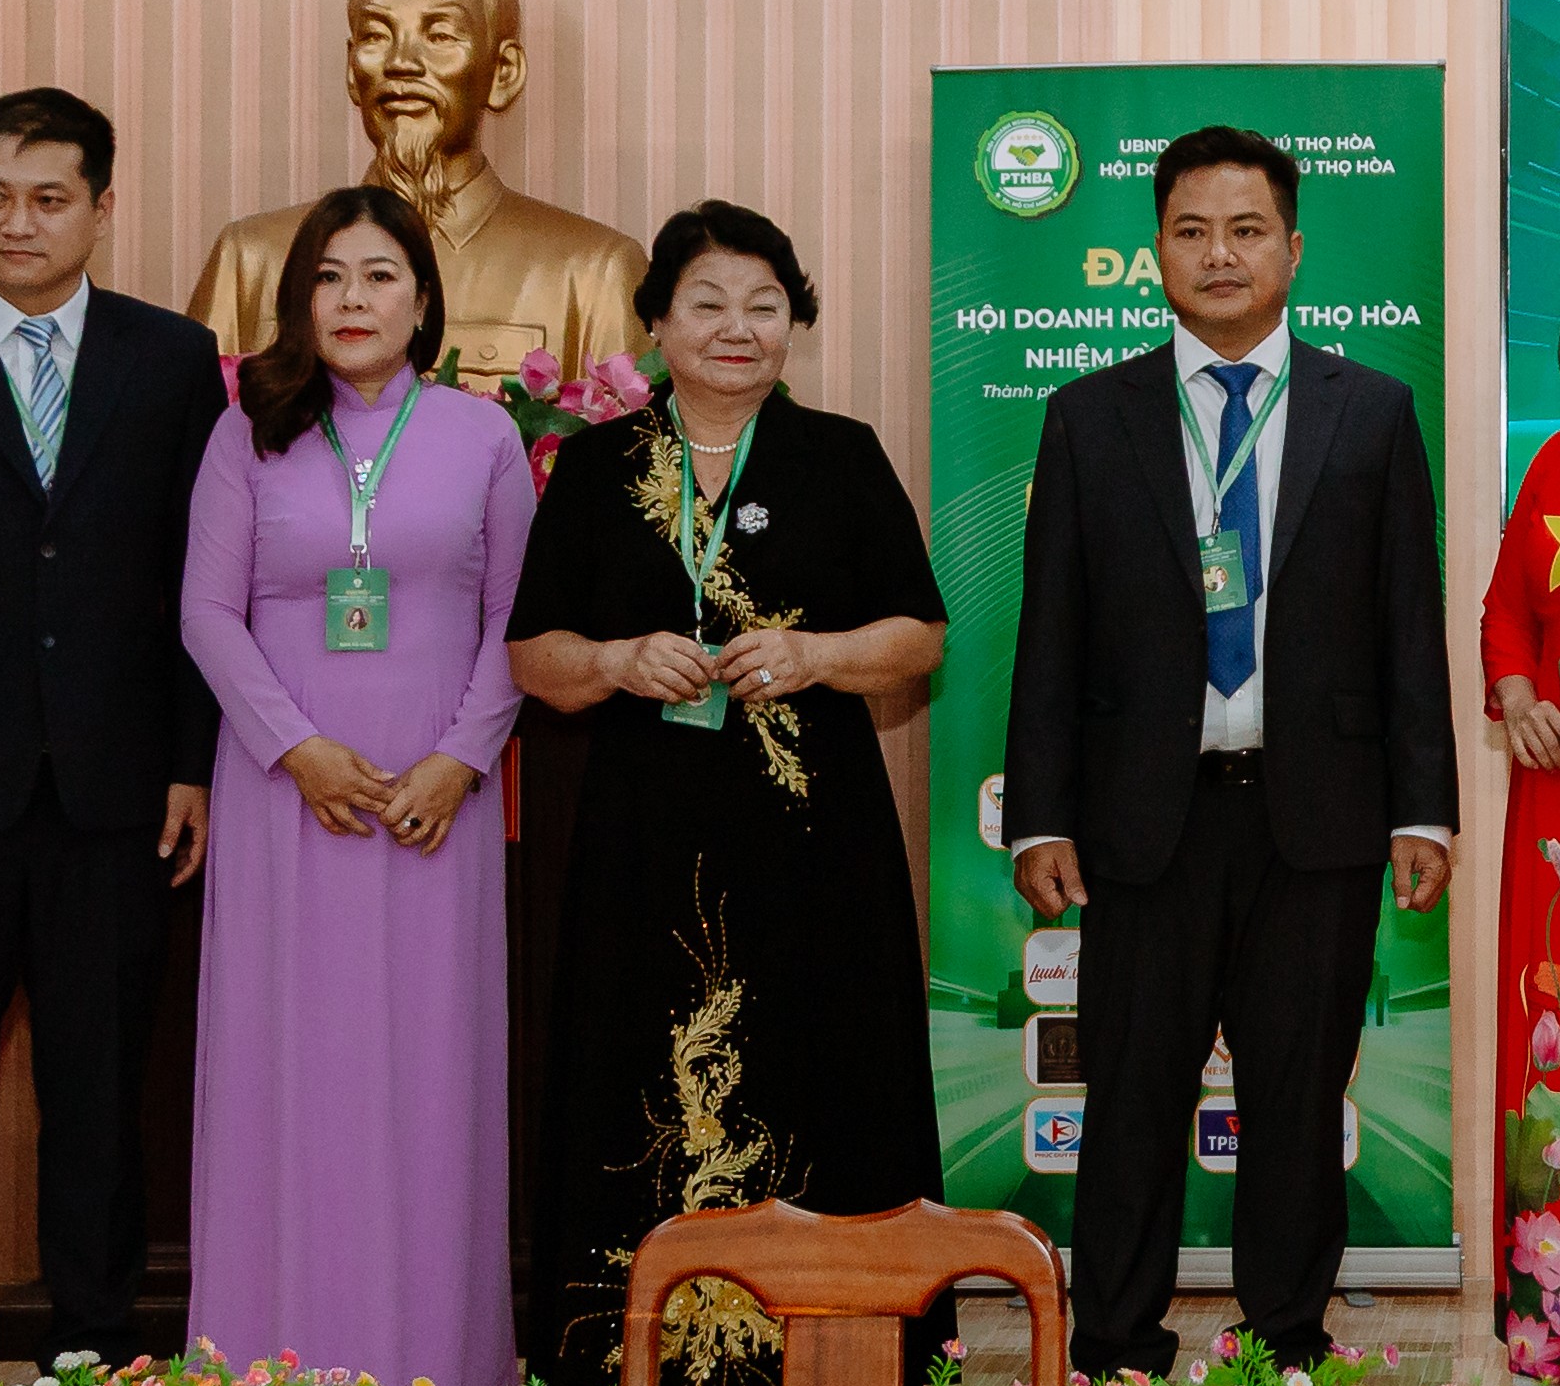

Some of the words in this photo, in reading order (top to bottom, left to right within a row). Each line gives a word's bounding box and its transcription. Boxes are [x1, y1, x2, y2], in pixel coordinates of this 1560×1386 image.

[1294, 136, 1333, 155] THỌ
[1336, 132, 1377, 151] HÒA
[999, 171, 1054, 185] PTHBA
[1099, 159, 1132, 180] HỘI
[1314, 159, 1353, 177] THỌ
[1356, 156, 1397, 174] HÒA
[956, 303, 1006, 335] HỘI
[1014, 307, 1114, 330] DOANH
[1295, 305, 1354, 331] THỌ
[1361, 300, 1422, 326] HÒA
[1025, 345, 1114, 375] NHIỆM
[982, 383, 1034, 399] Thành
